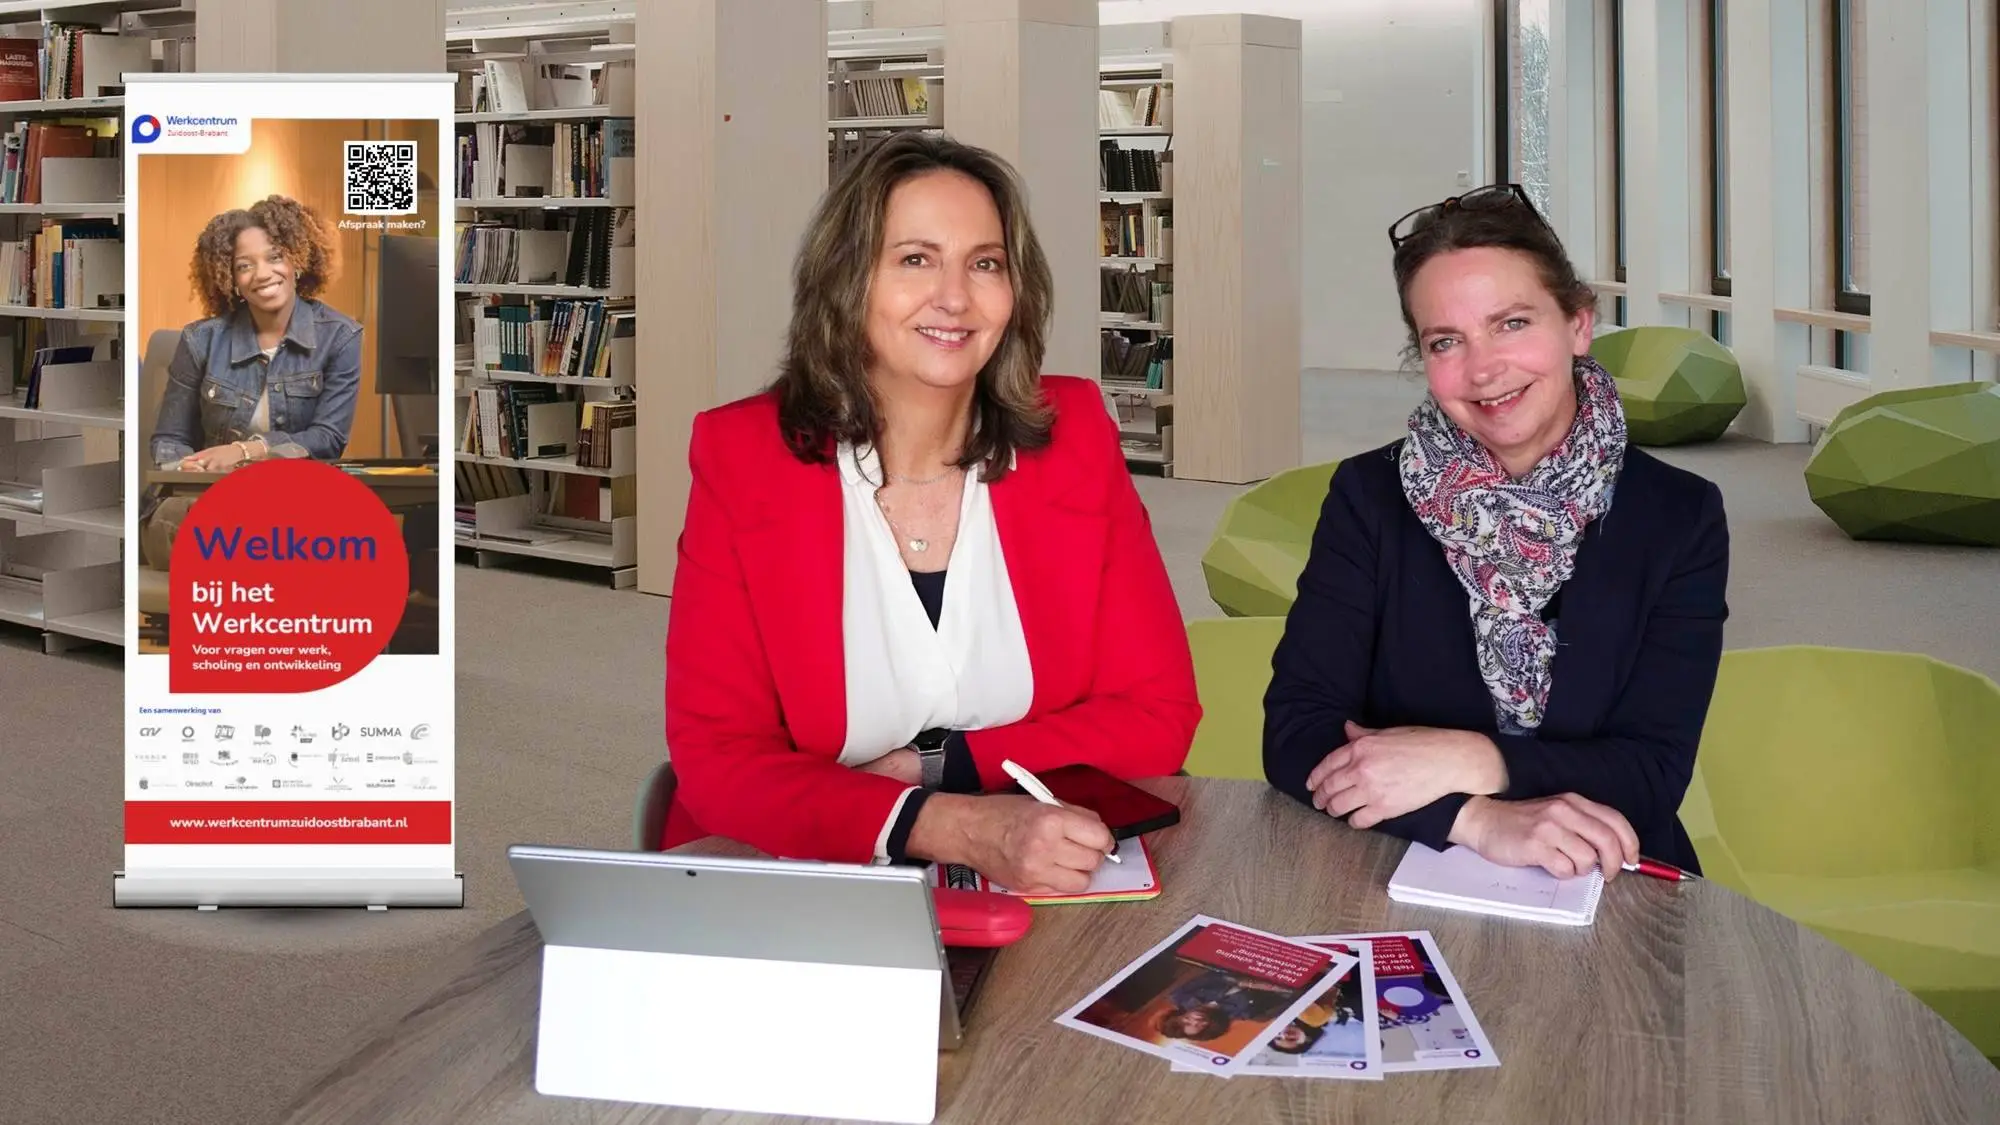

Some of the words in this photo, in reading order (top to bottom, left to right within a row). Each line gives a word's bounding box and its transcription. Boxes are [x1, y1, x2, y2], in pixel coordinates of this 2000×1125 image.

[166, 115, 237, 126] Werkcentrum
[167, 129, 228, 137] Zuidoost-Brabant
[338, 219, 384, 230] Afspraak
[387, 219, 426, 229] maken?
[193, 526, 376, 560] Welkom
[192, 581, 222, 607] bij
[231, 581, 274, 602] het
[192, 612, 372, 633] Werkcentrum
[192, 645, 221, 655] Voor
[224, 646, 265, 657] vragen
[268, 646, 295, 655] over
[298, 645, 331, 656] werk,
[192, 659, 242, 671] scholing
[246, 662, 260, 670] en
[264, 659, 341, 671] ontwikkeling
[153, 707, 206, 715] samenwerking
[360, 727, 402, 737] SUMMA
[170, 817, 408, 828] www.werkcentrumzuidoostbrabant.nl
